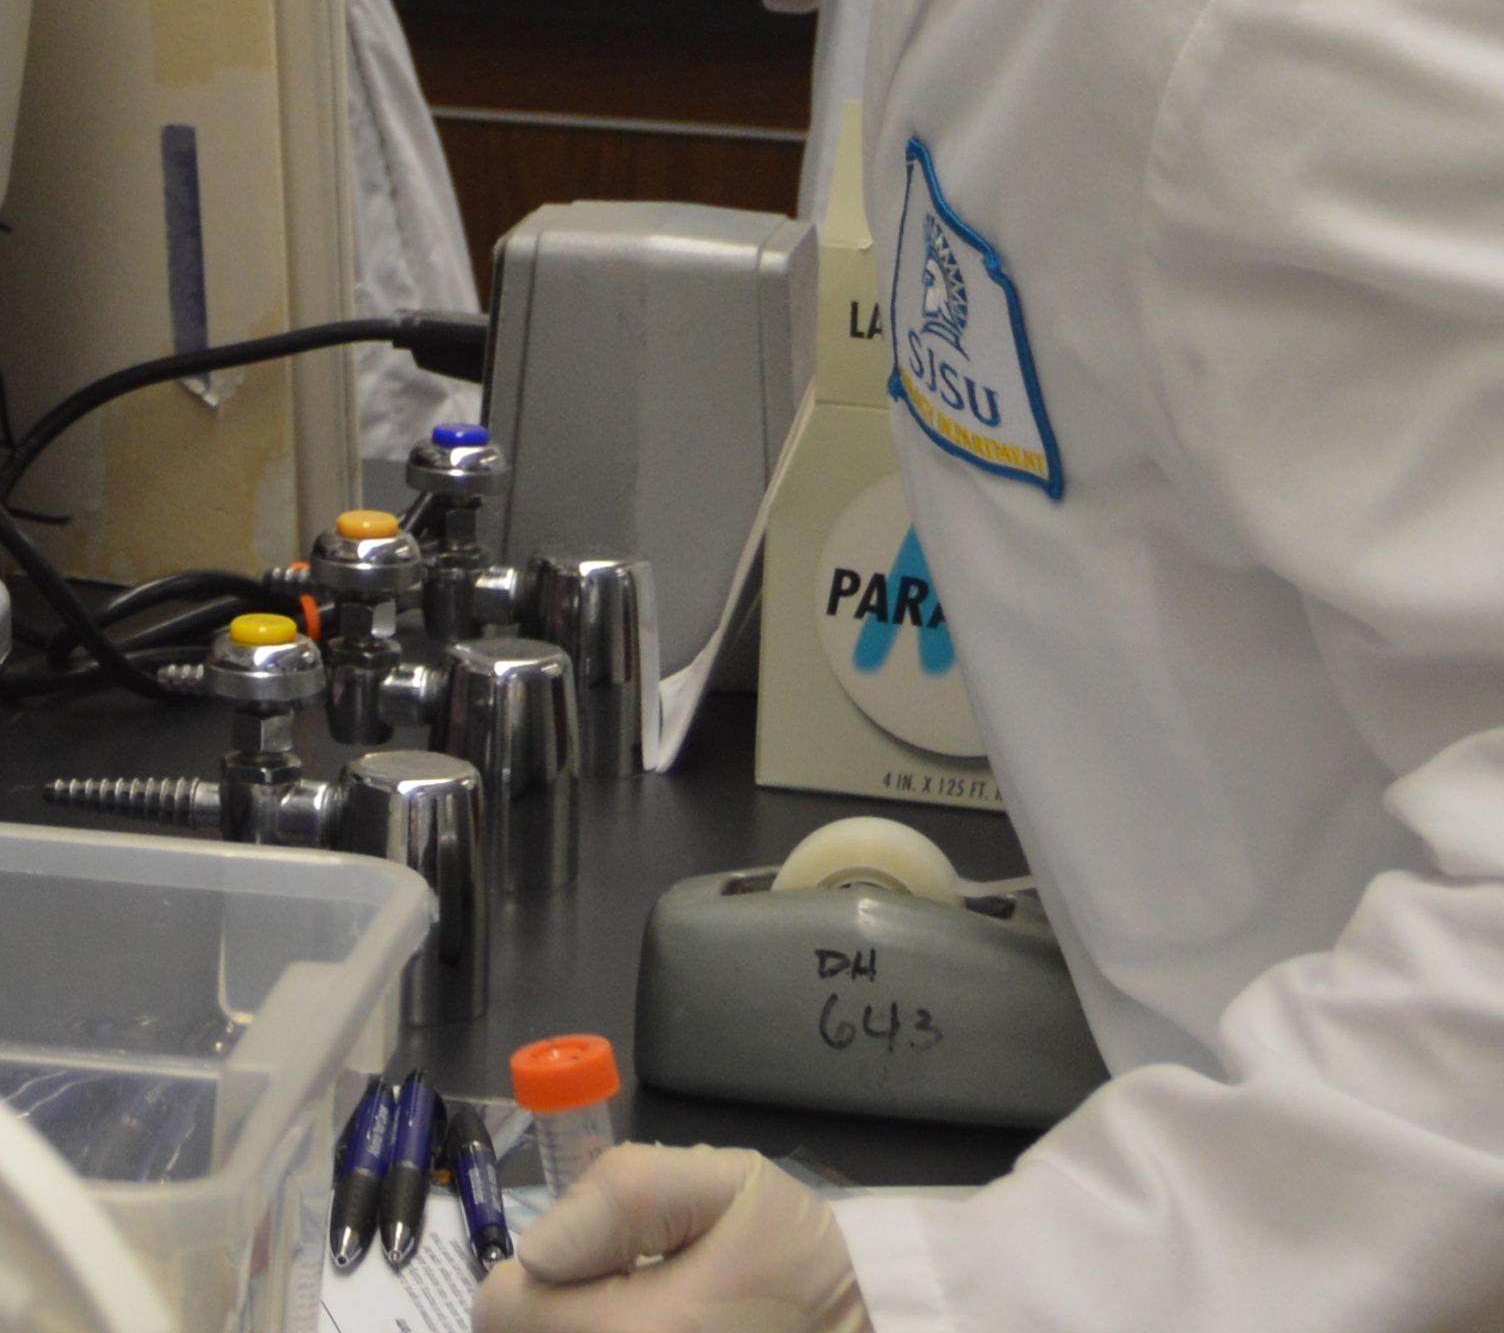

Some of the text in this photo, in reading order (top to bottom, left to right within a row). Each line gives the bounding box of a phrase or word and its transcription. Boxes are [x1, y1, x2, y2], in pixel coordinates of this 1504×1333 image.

[908, 329, 1002, 428] SJSU
[882, 771, 892, 789] 4
[938, 777, 965, 797] 125
[818, 992, 944, 1053] 643
